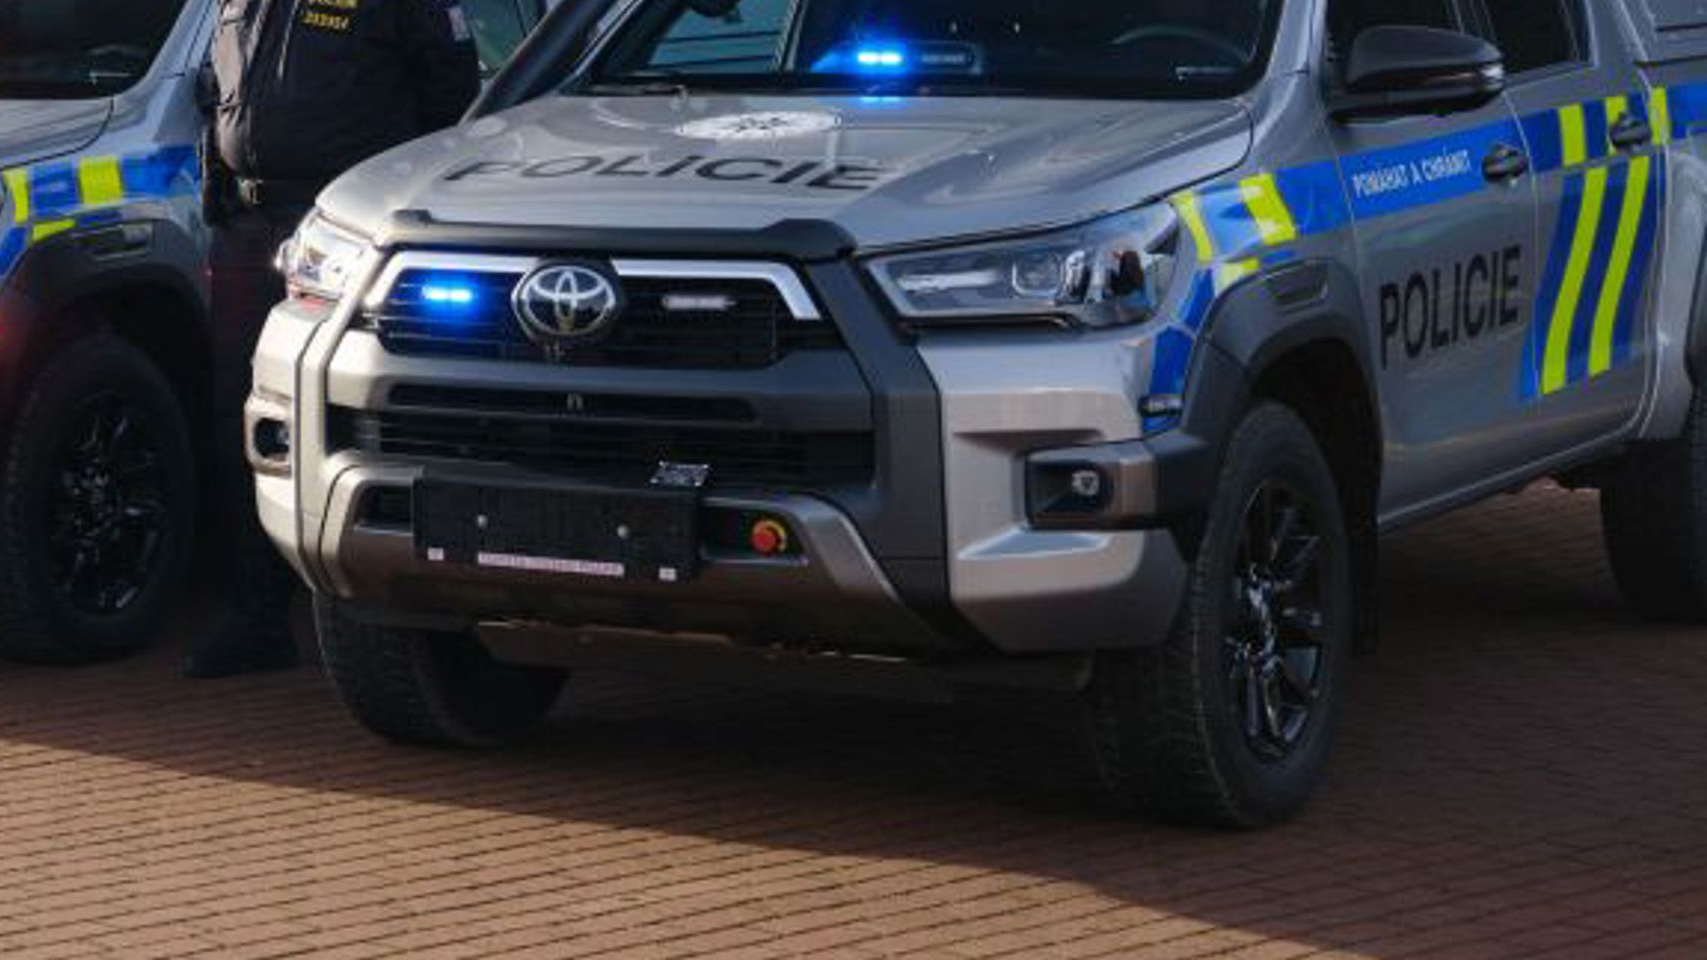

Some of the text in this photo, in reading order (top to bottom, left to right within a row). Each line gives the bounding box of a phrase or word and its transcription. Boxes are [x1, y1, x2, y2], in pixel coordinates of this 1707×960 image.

[443, 154, 882, 191] POLICIE
[1410, 161, 1423, 185] A
[1379, 244, 1521, 370] POLICIE
